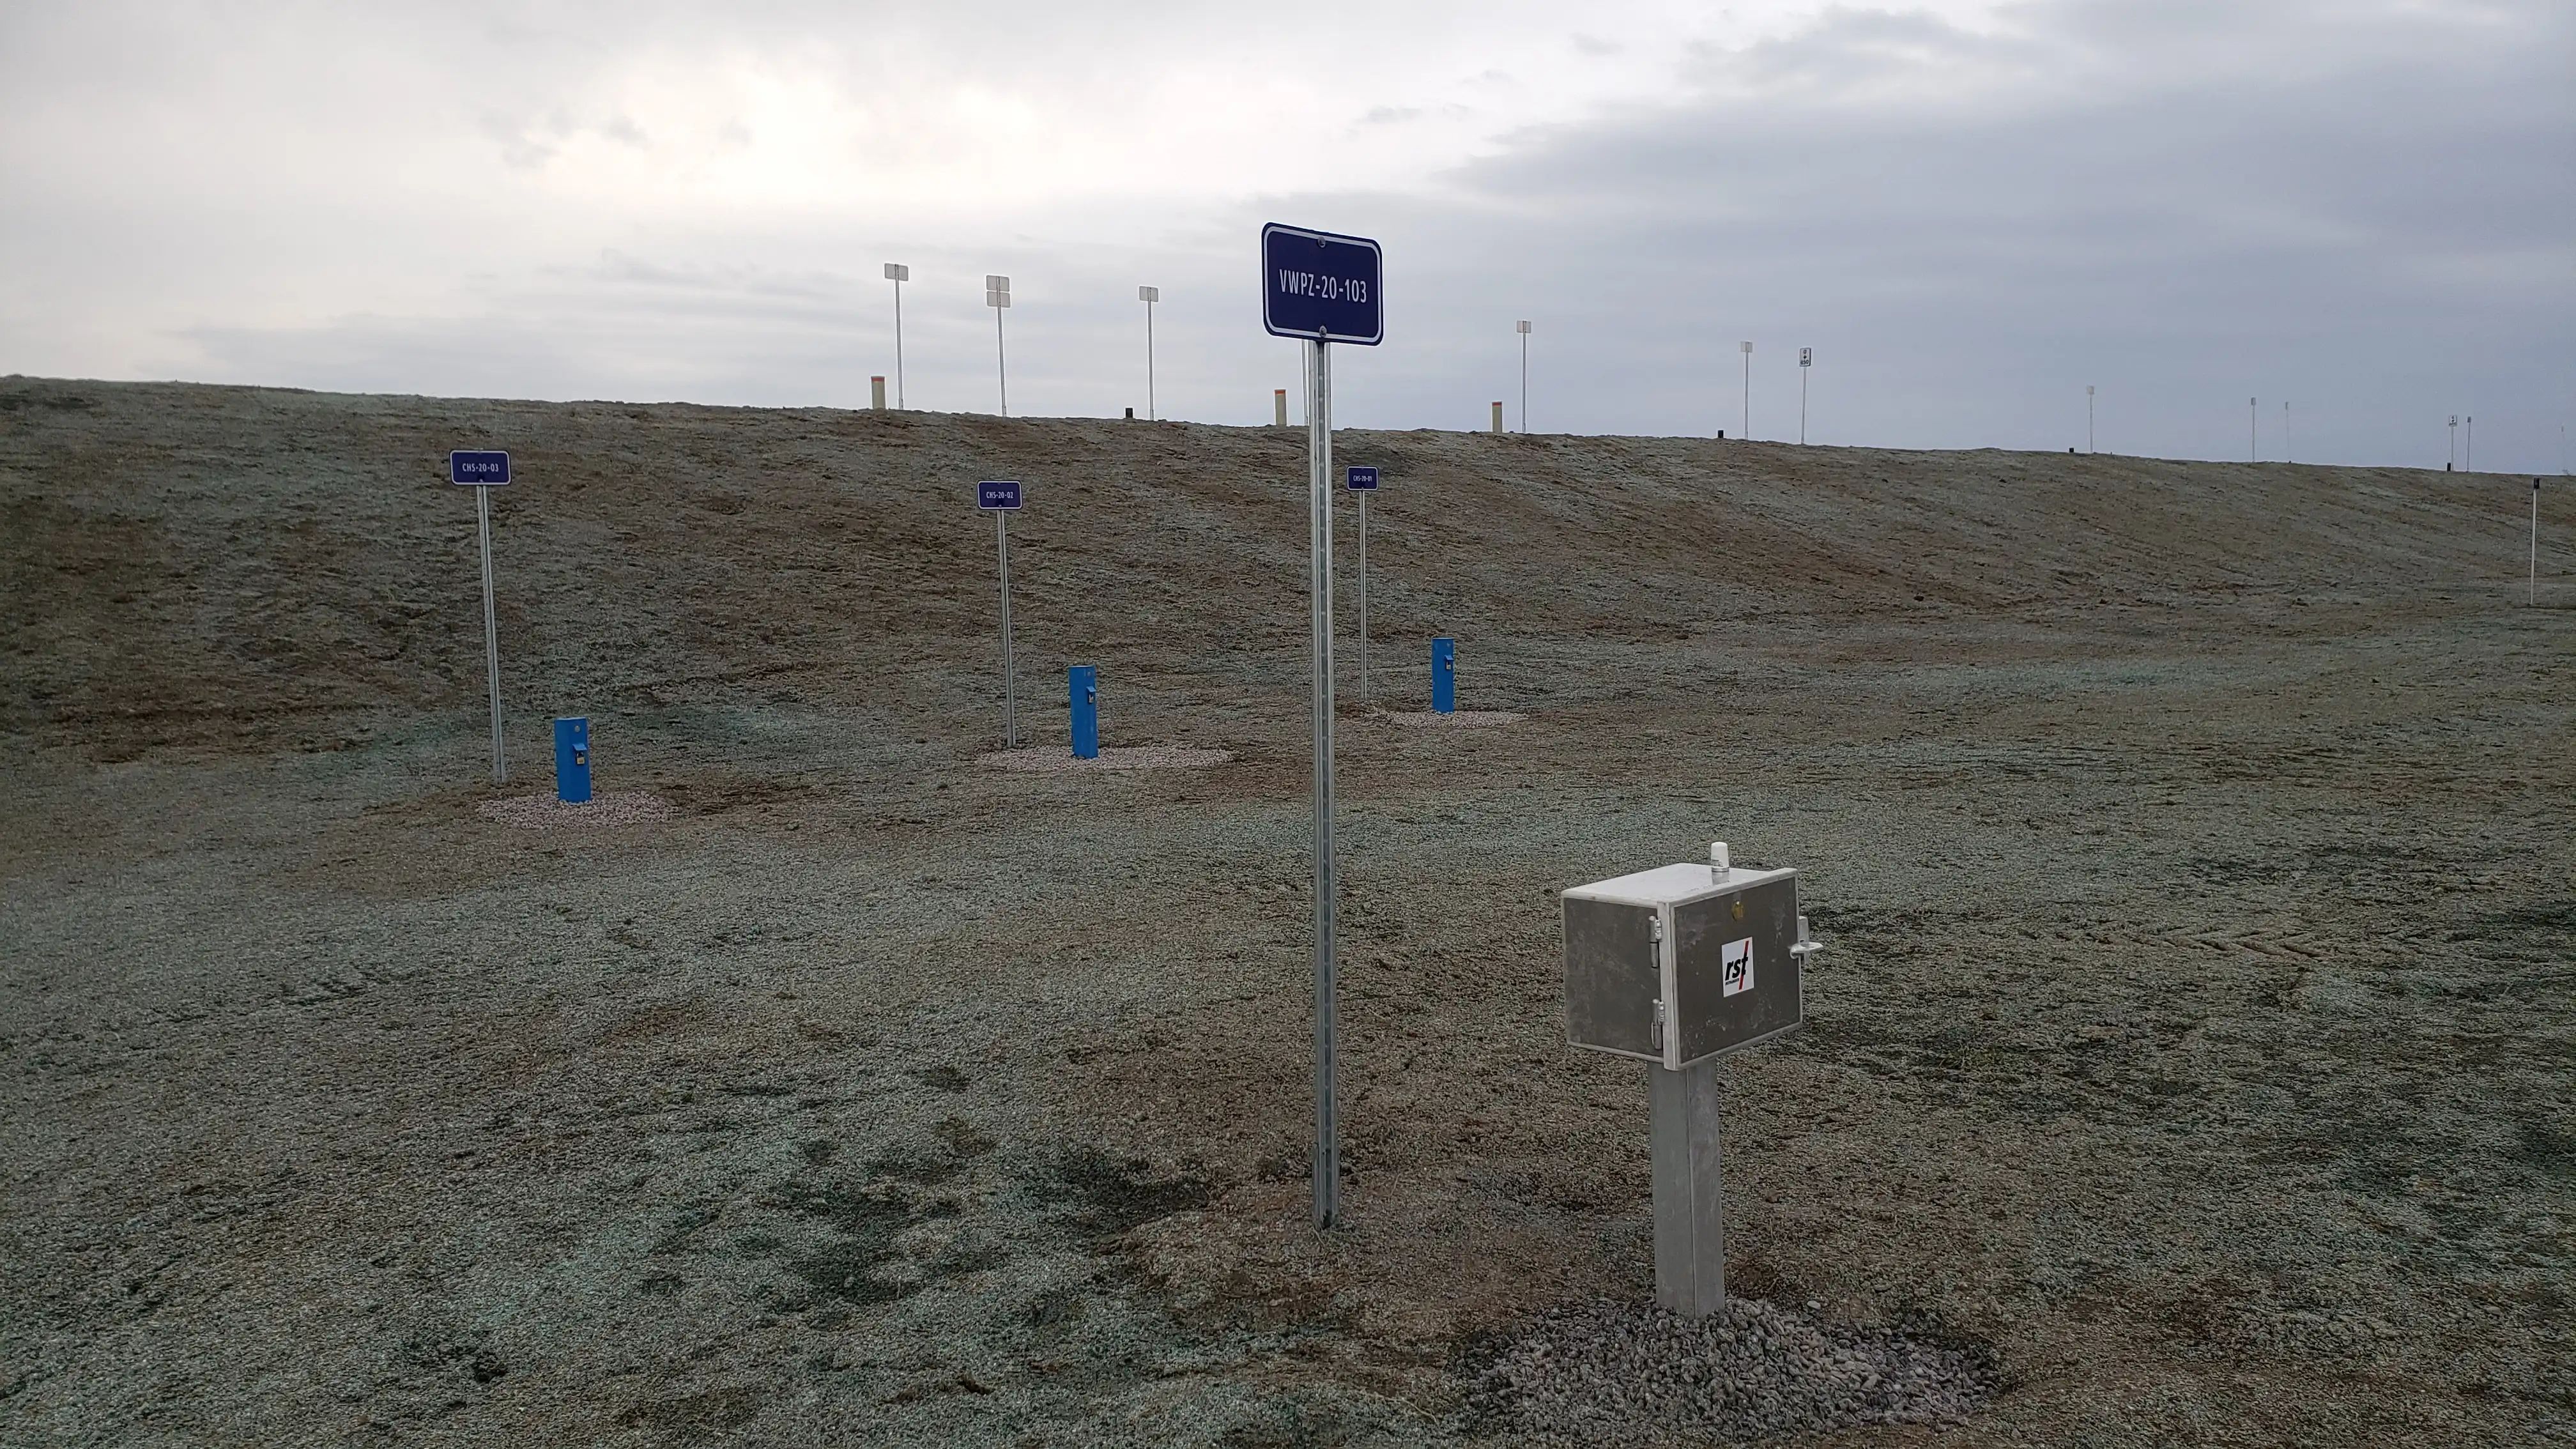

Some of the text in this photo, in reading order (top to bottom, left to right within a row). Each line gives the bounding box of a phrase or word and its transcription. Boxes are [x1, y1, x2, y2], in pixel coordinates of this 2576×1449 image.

[1279, 268, 1367, 303] VWPZ-20-103
[462, 463, 499, 472] CHS-20-03
[1725, 953, 1749, 981] rst
